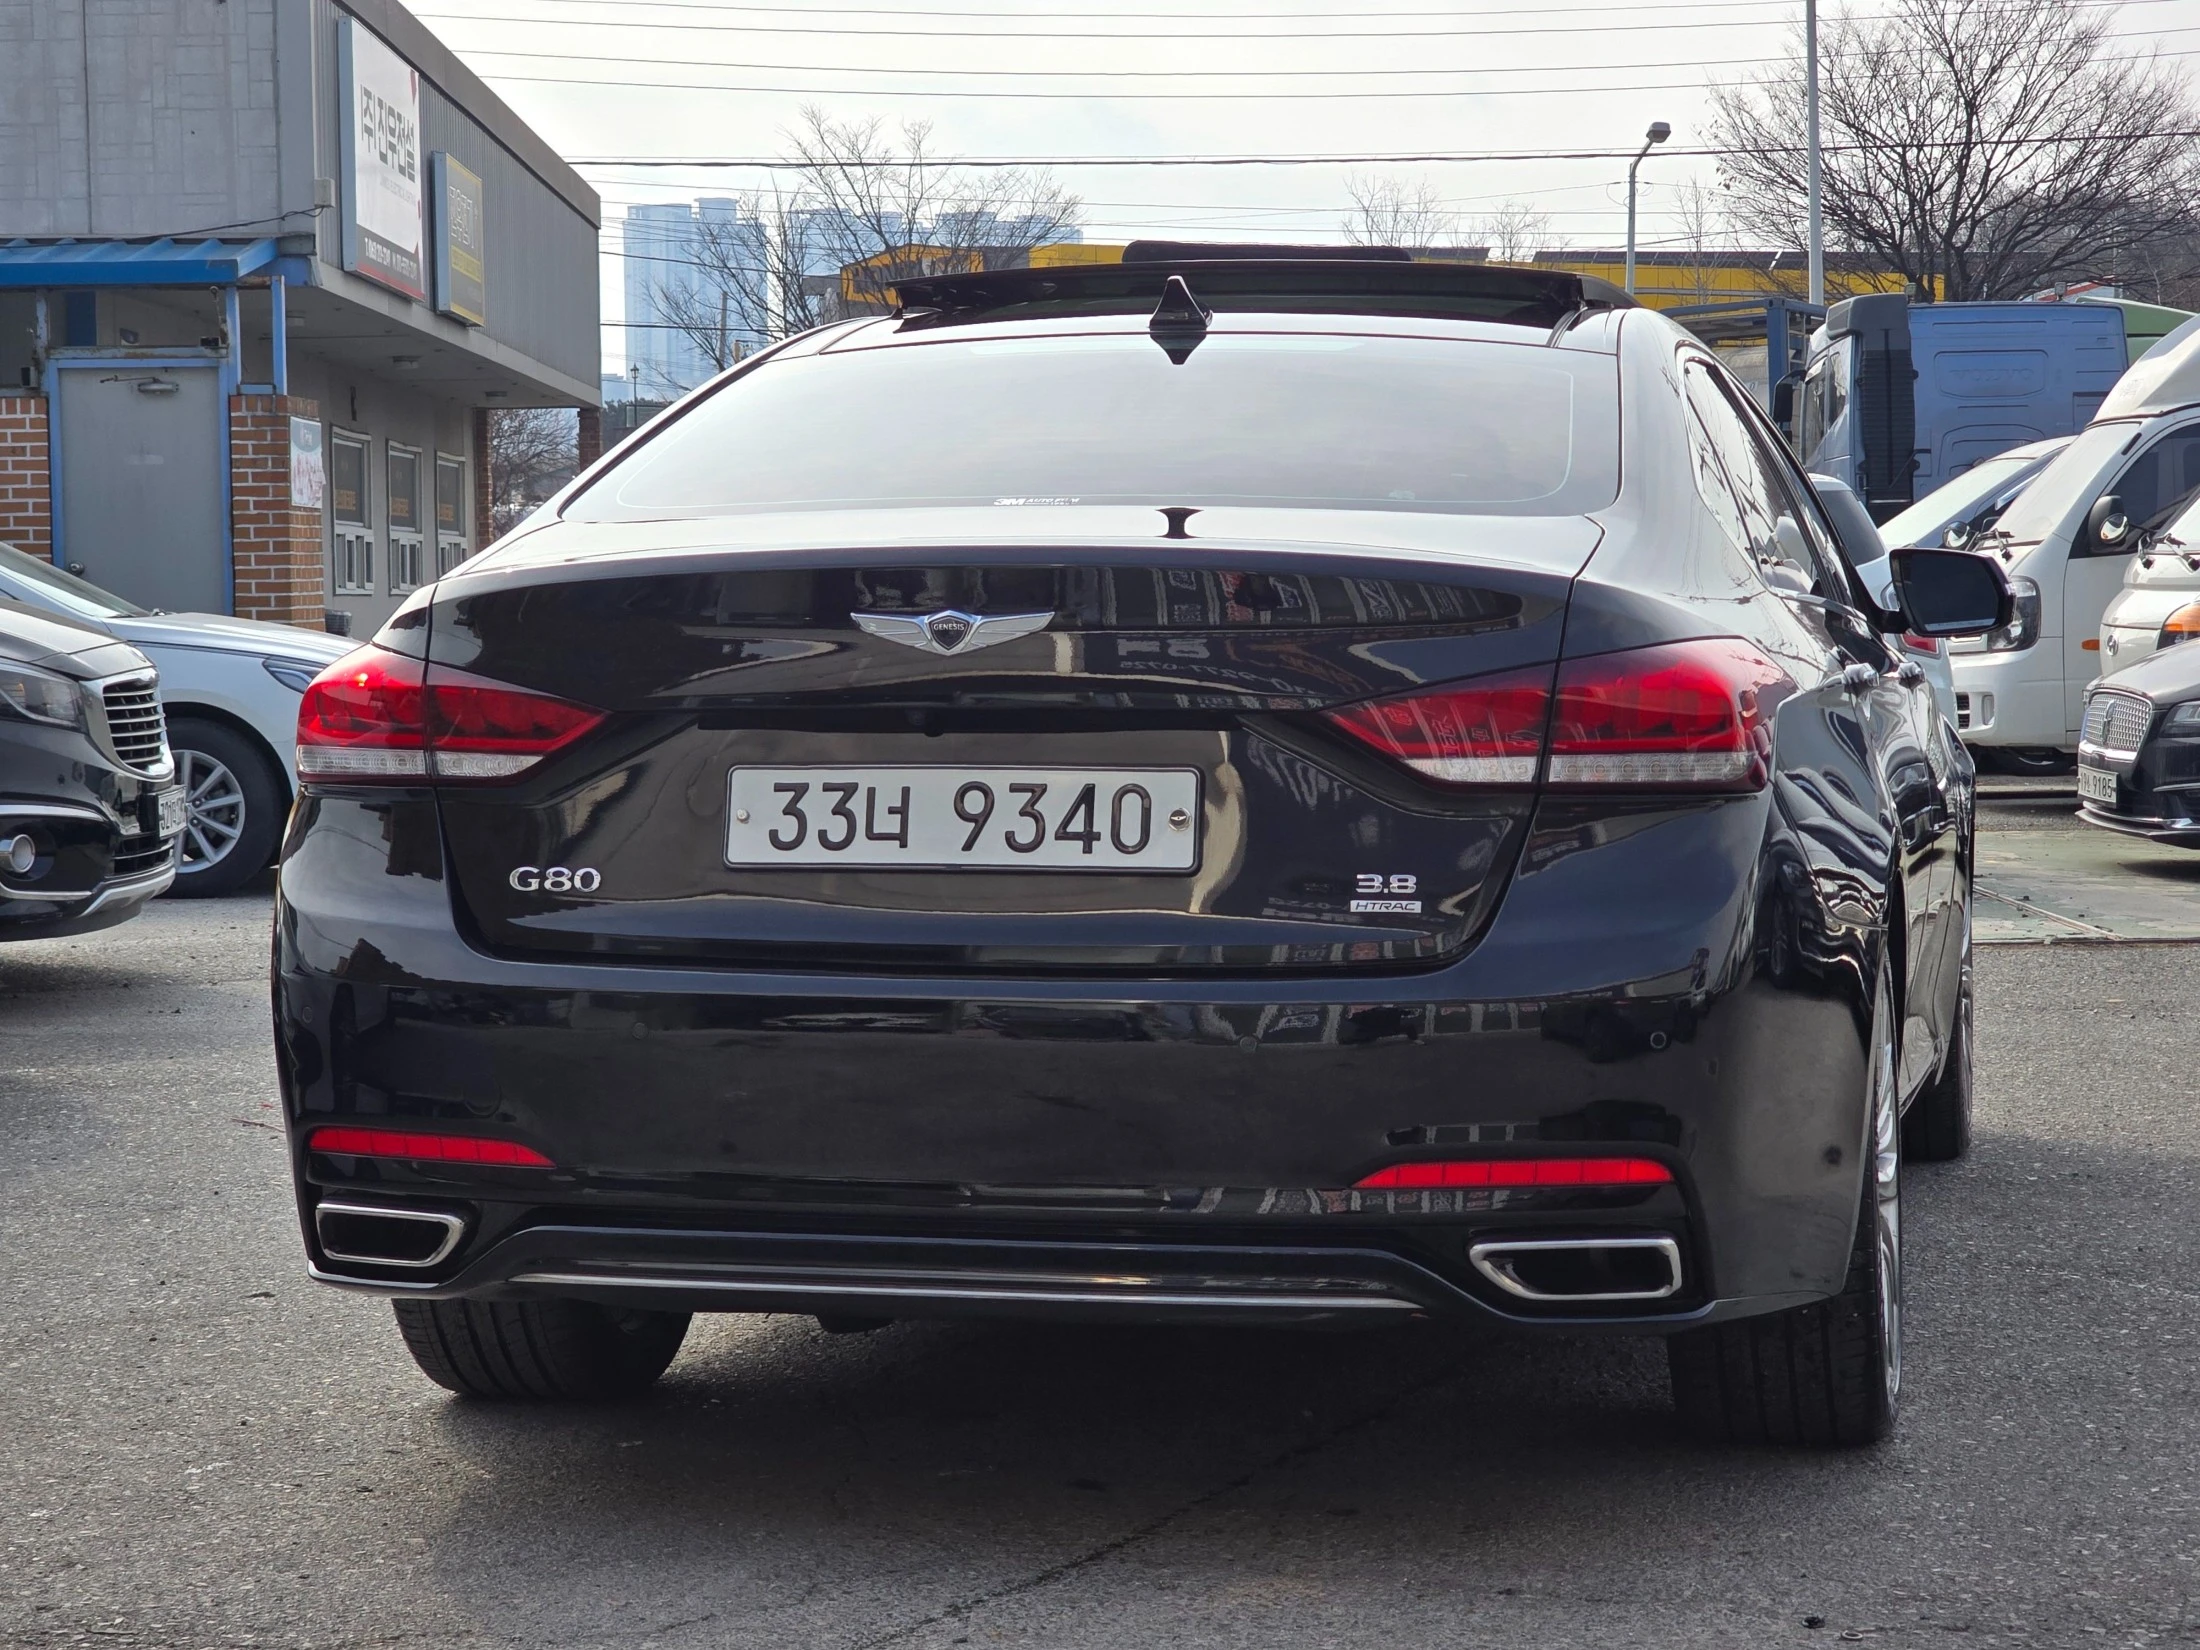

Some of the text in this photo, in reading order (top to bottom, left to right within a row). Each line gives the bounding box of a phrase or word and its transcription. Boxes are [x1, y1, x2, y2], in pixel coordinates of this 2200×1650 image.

[933, 623, 965, 631] GENESIS
[2093, 775, 2113, 798] 9185
[768, 781, 1152, 855] 33너 9340
[509, 866, 602, 893] G80
[1355, 873, 1417, 894] 3.8
[1355, 901, 1416, 911] HTRAC
